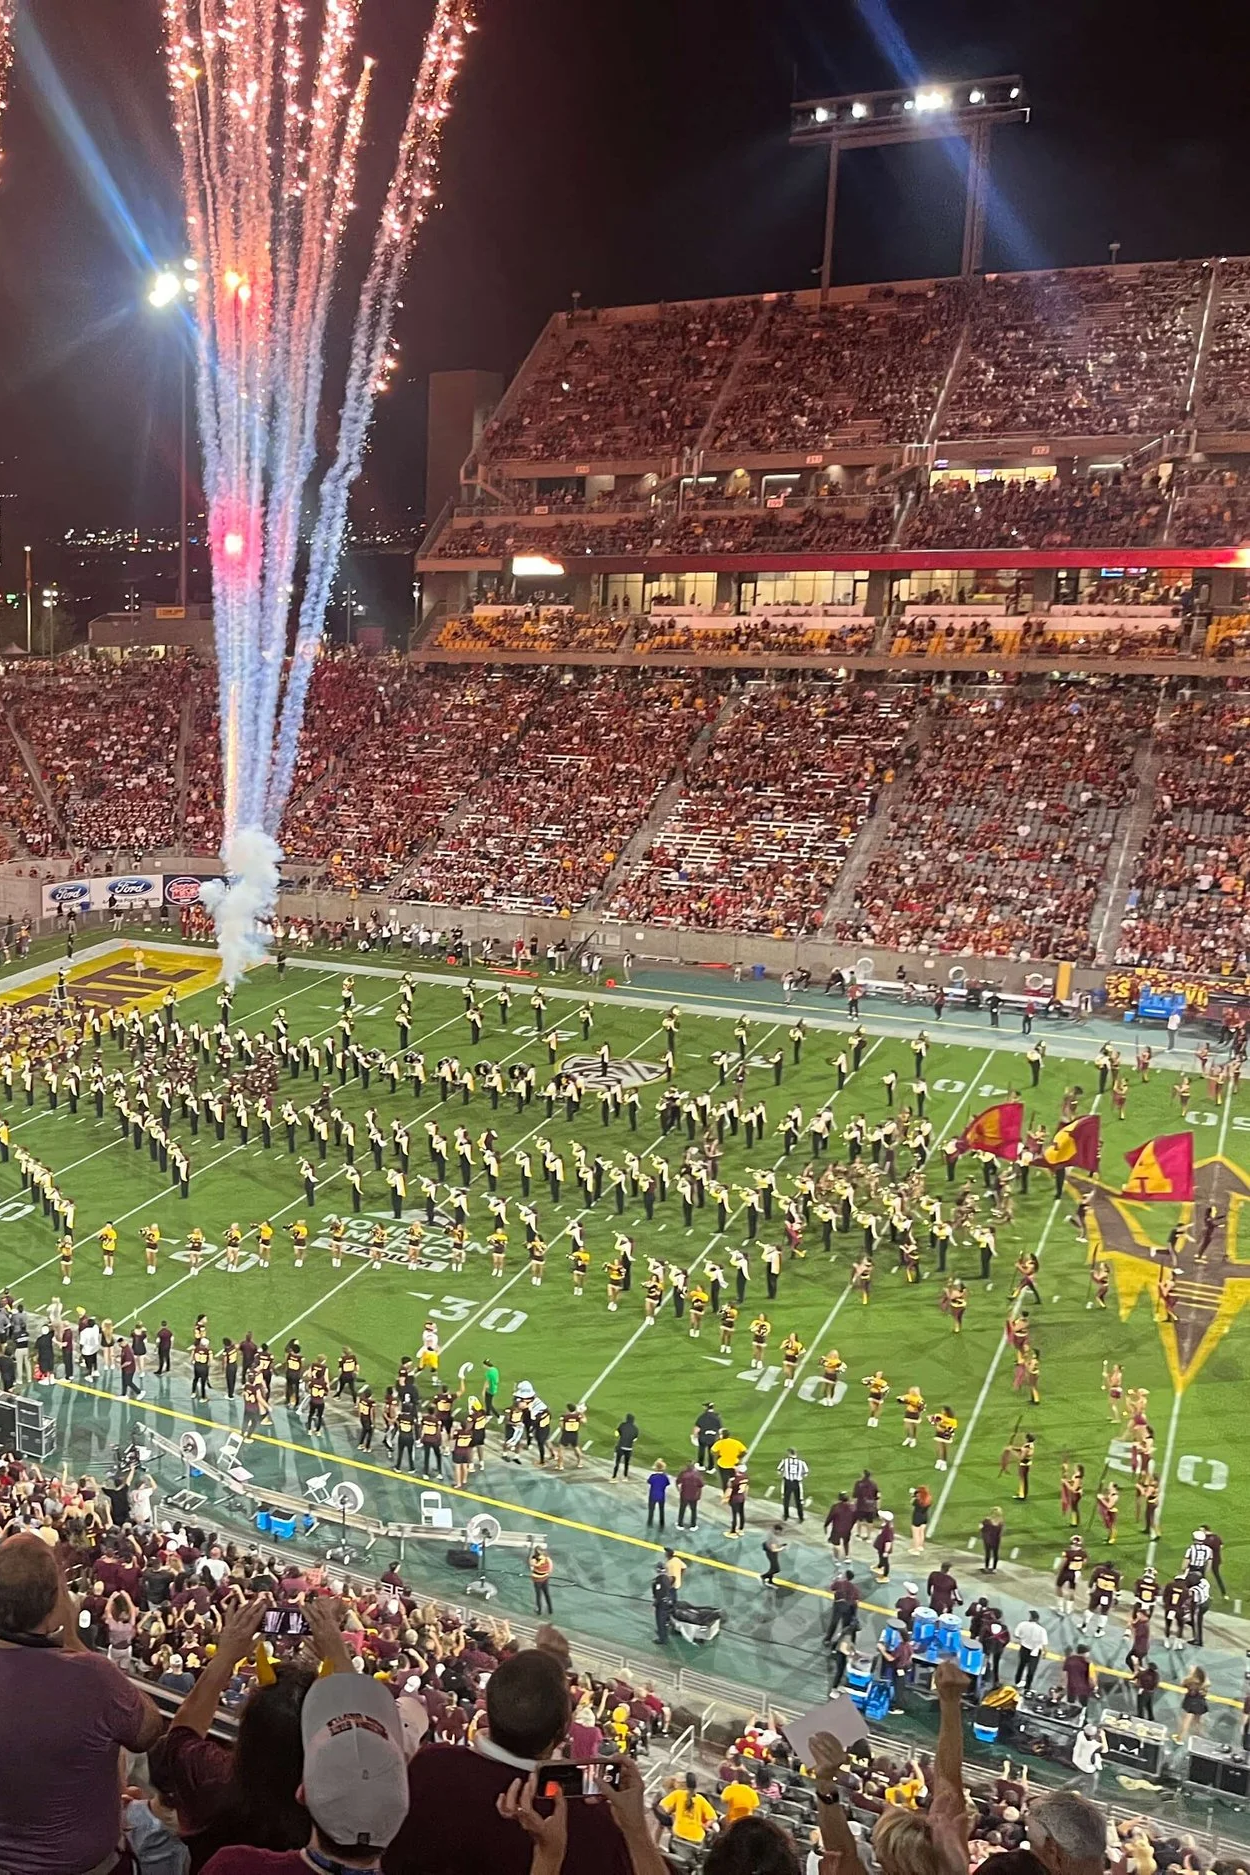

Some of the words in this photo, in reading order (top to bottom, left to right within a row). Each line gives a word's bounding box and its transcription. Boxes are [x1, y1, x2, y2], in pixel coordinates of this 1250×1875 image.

[56, 886, 82, 900] Ford
[114, 880, 146, 894] Ford
[169, 1242, 261, 1273] 20
[429, 1295, 529, 1333] 30
[736, 1364, 848, 1406] 40
